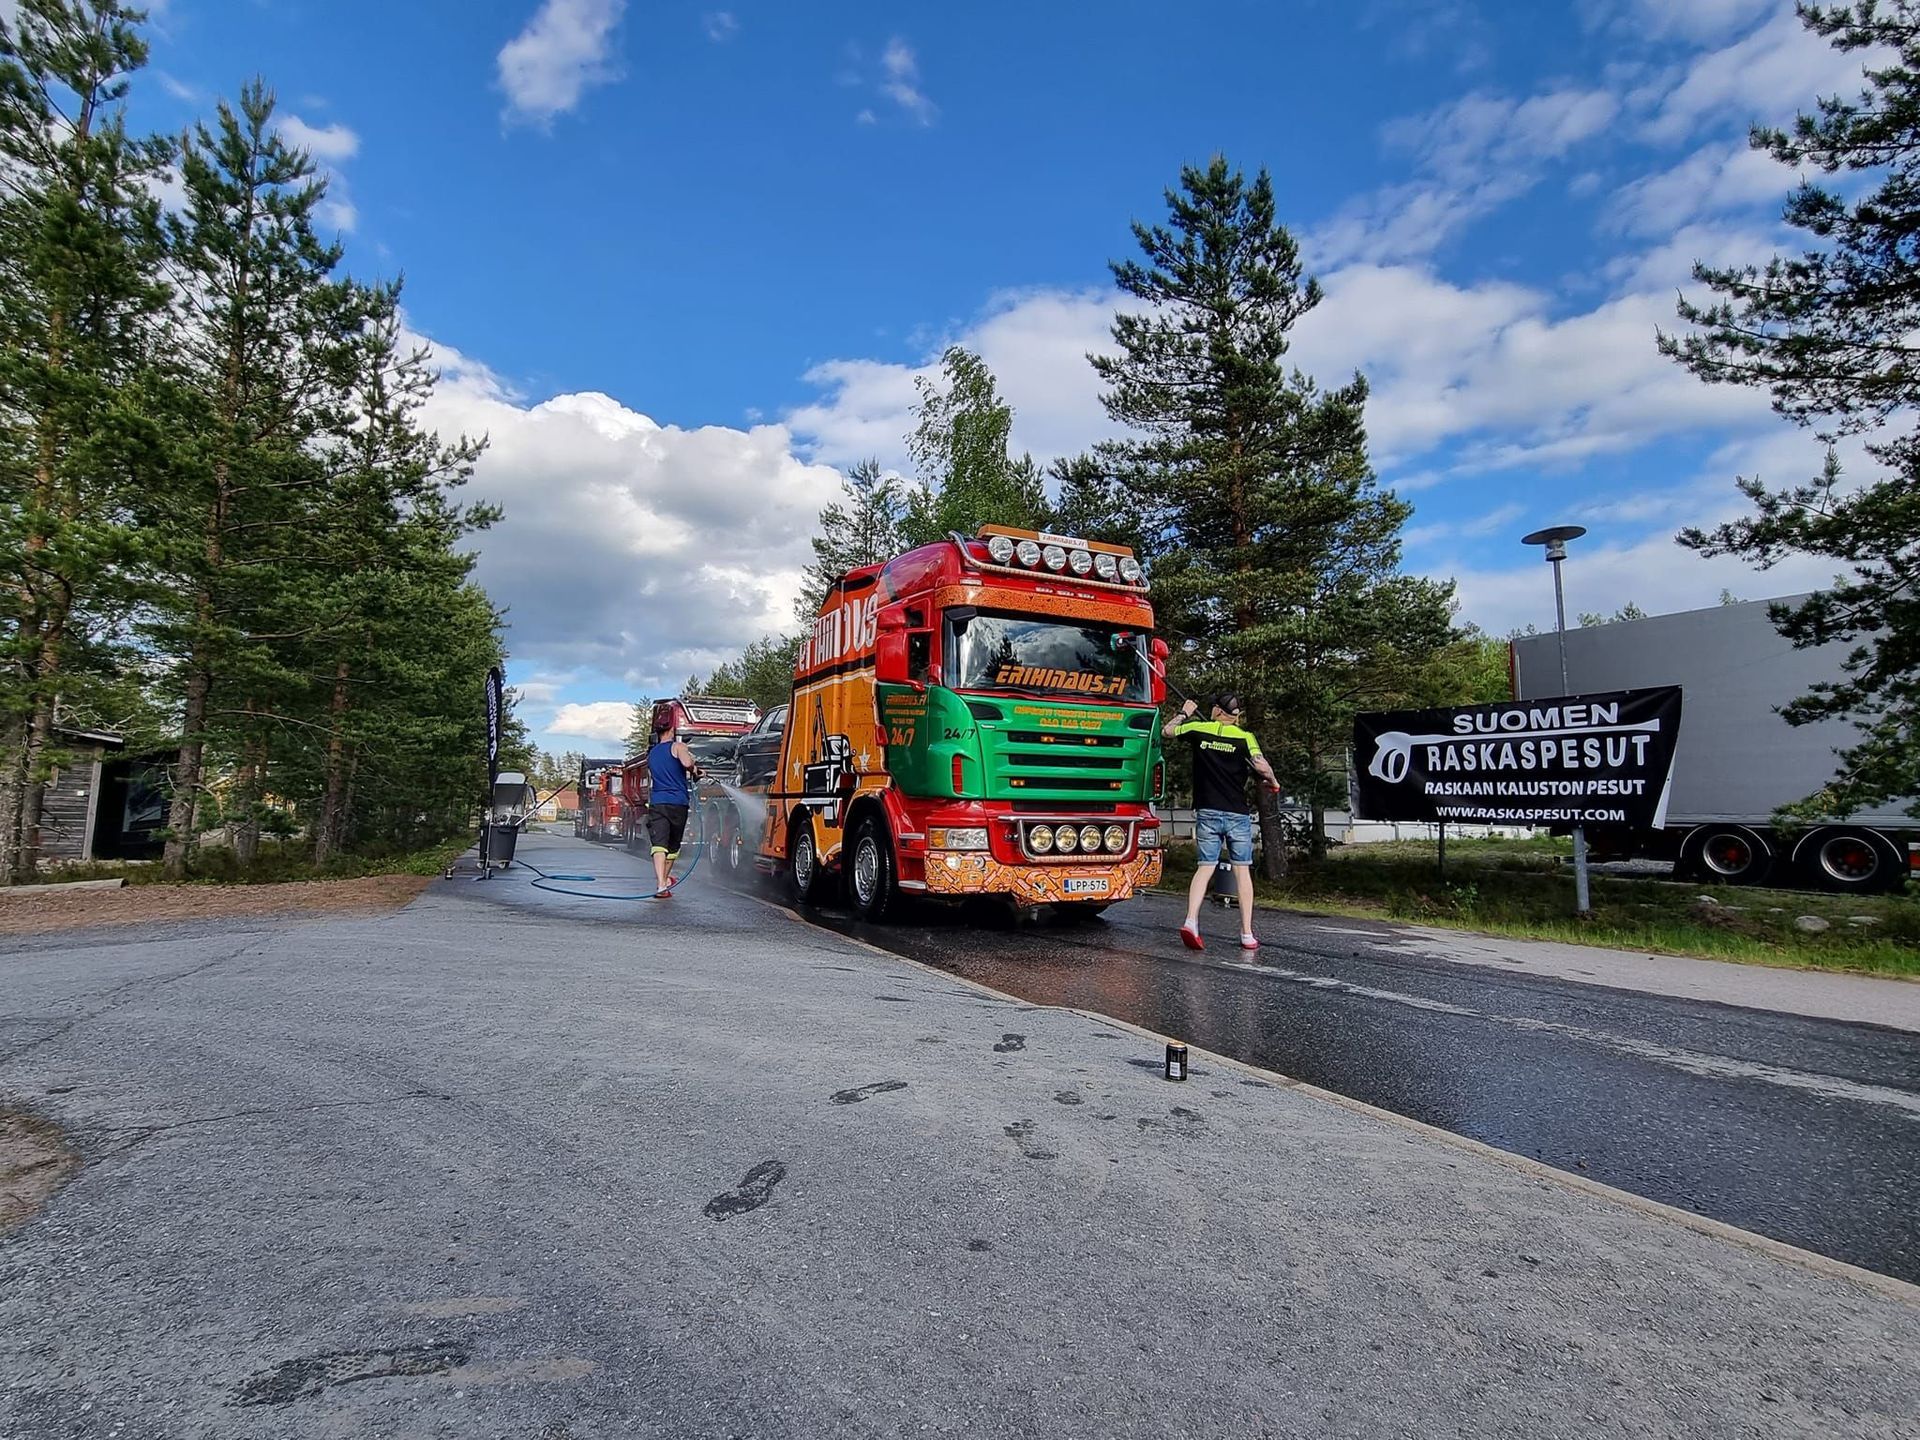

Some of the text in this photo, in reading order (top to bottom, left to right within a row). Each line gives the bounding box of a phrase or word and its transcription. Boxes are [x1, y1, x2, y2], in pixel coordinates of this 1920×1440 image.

[996, 665, 1127, 695] ERIHINAUS.FI
[1453, 702, 1619, 734] SUOMEN
[891, 727, 915, 747] 24/7
[944, 728, 976, 740] 24/7
[1427, 735, 1650, 771] RASKASPESUT
[1425, 779, 1646, 796] RASKAAN KALUSTON PESUT
[1436, 806, 1625, 822] WWW.RASKASPESUT.COM
[1070, 880, 1107, 892] LPP-575
